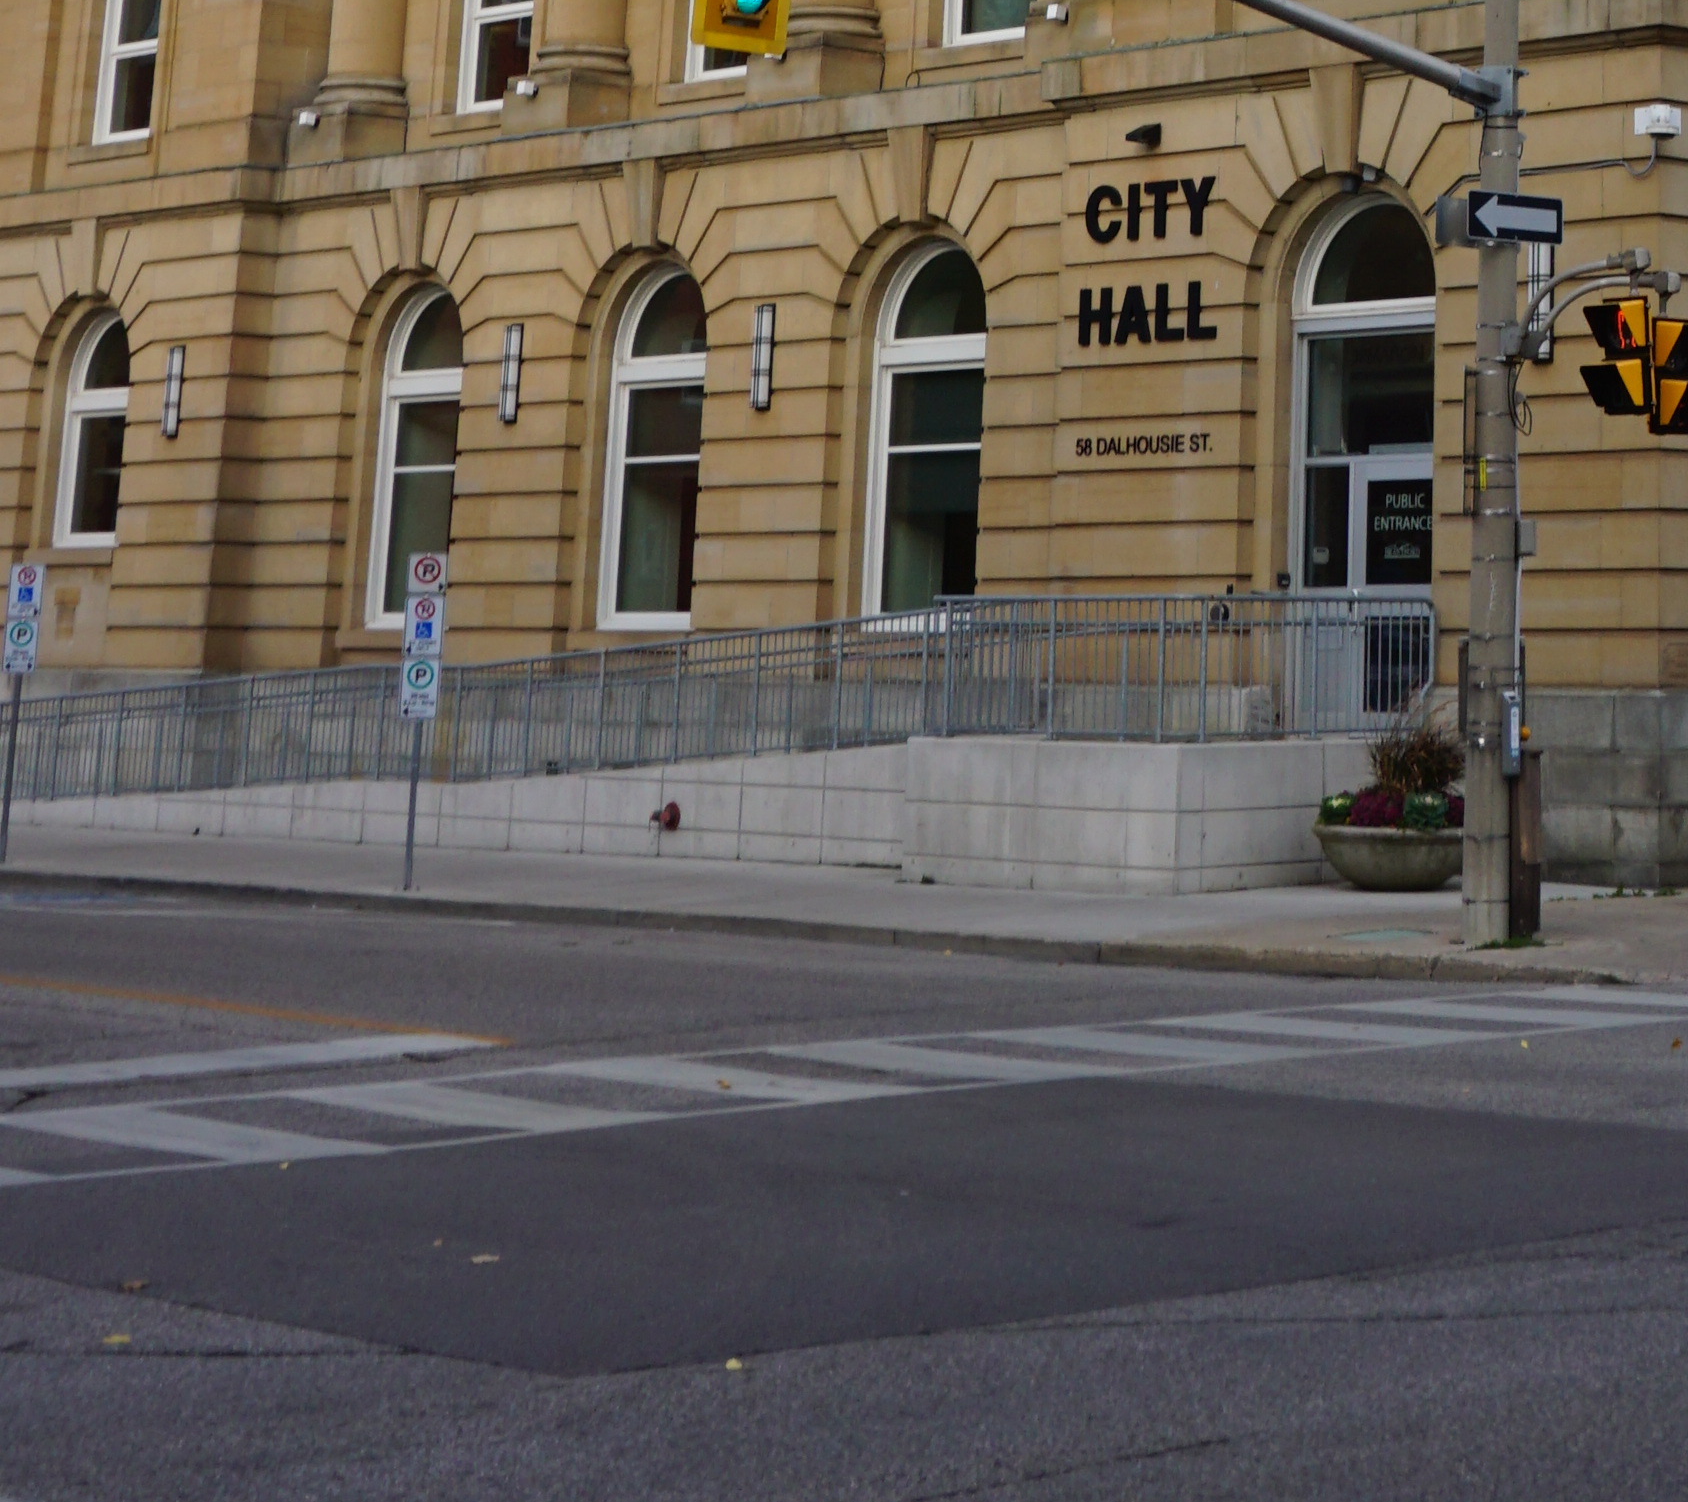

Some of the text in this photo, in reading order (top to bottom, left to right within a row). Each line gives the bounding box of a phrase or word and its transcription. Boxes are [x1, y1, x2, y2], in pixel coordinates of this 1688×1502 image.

[1085, 176, 1216, 244] CITY
[1078, 280, 1217, 347] HALL
[1076, 433, 1213, 457] 58 DALHOUSIE ST.
[1385, 493, 1425, 509] PUBLIC
[1373, 515, 1433, 532] ENTRANCE
